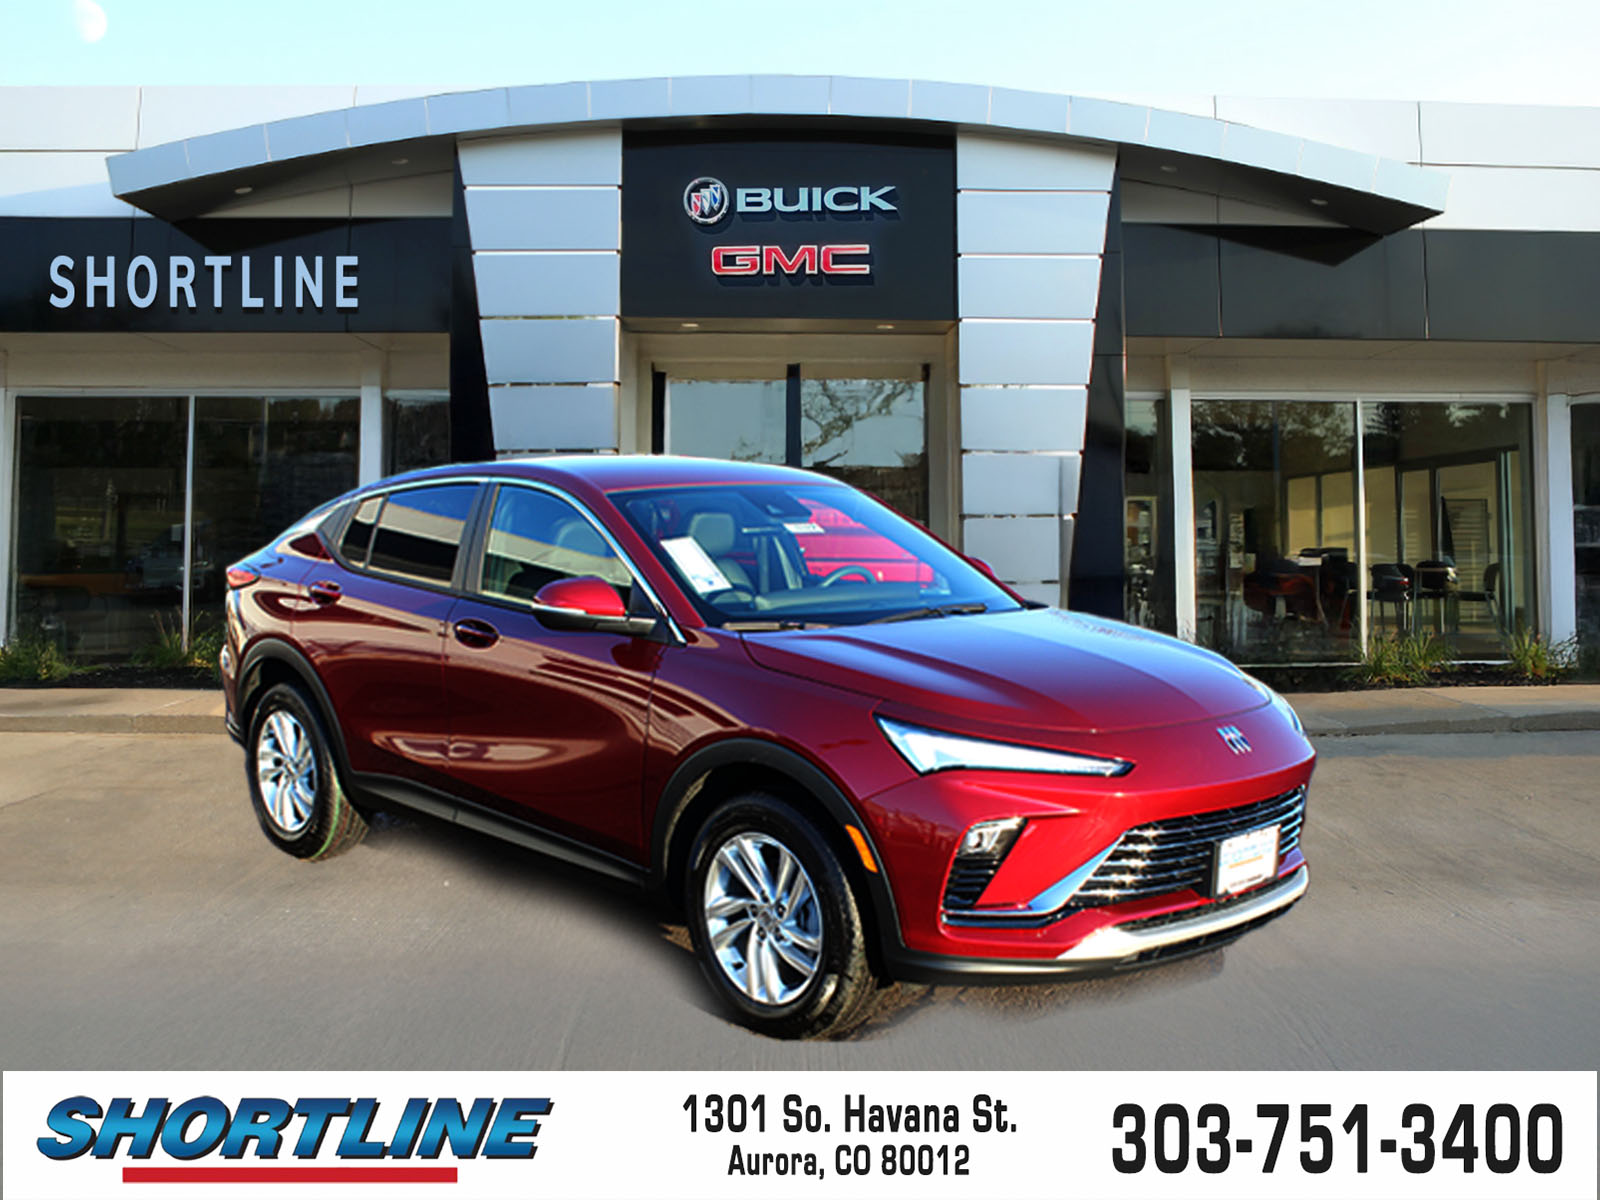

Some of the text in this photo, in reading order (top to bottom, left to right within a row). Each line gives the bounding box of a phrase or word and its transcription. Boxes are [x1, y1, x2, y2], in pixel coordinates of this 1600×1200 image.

[736, 186, 898, 213] BUICK
[711, 244, 870, 276] GMC
[49, 255, 359, 309] SHORTLINE
